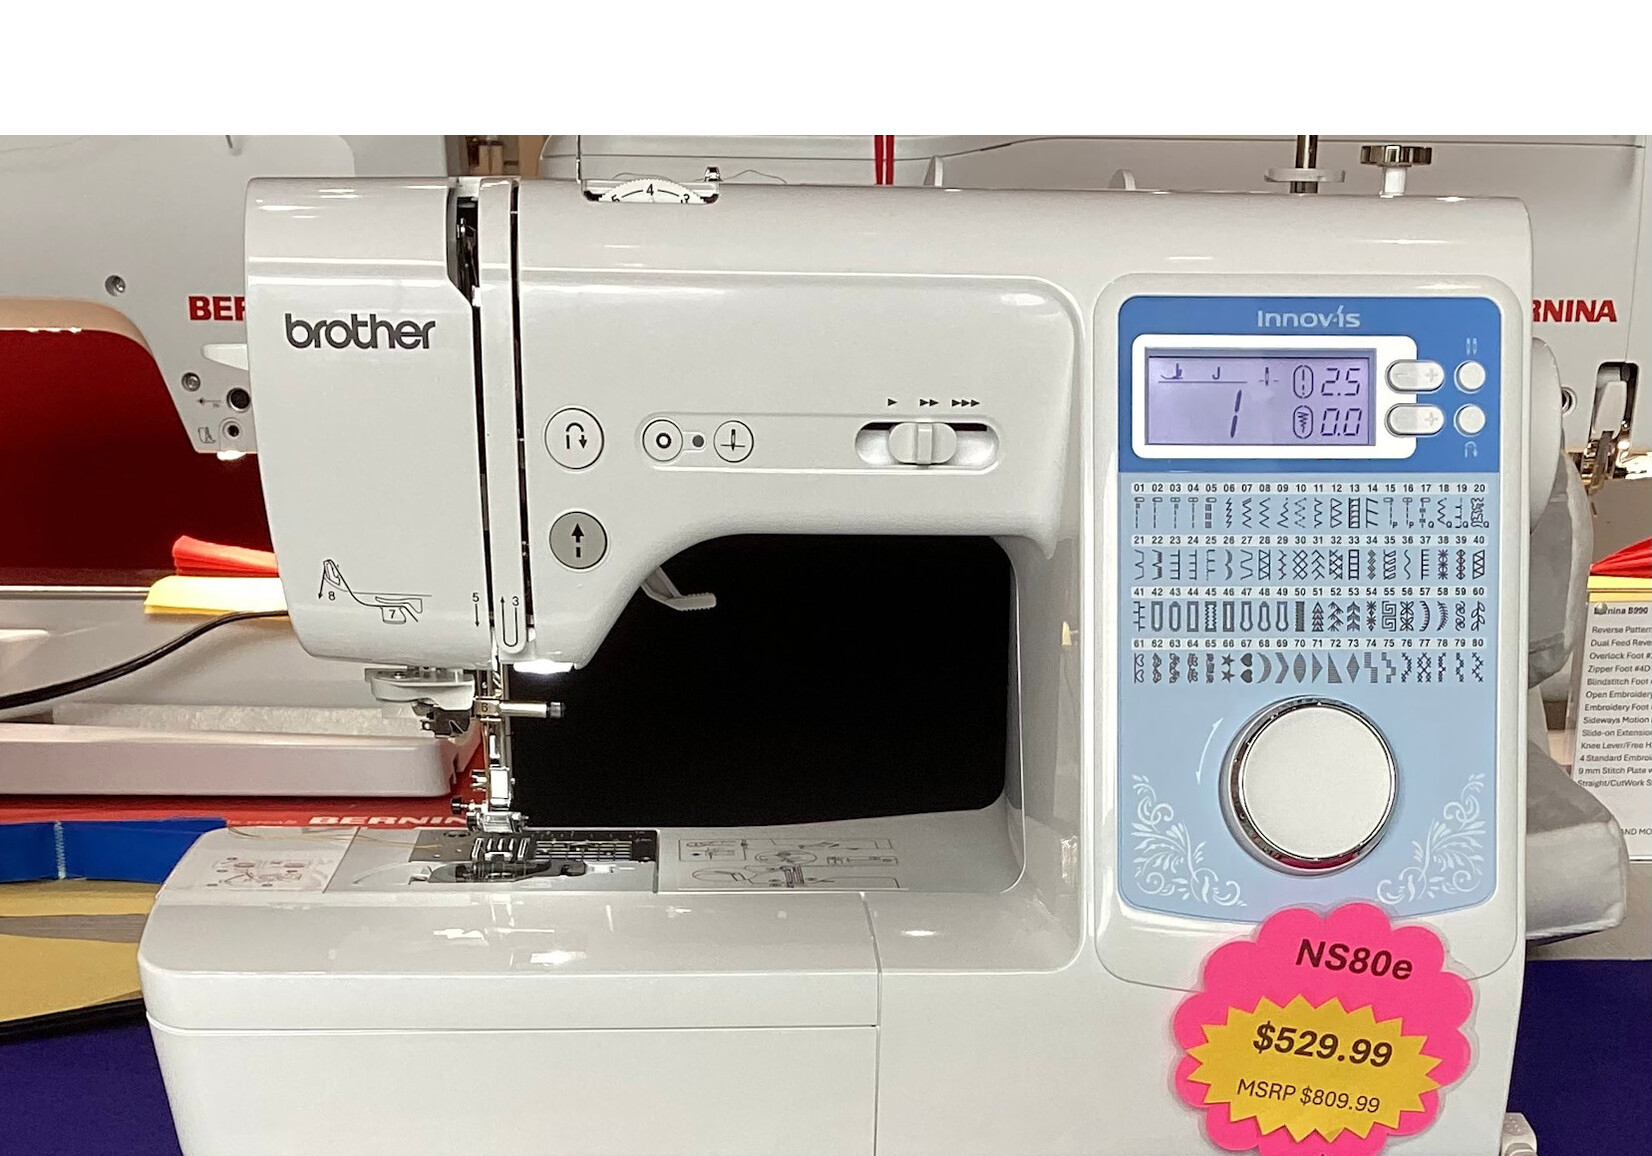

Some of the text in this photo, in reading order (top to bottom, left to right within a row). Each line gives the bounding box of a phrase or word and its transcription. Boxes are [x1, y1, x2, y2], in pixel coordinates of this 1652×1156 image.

[646, 183, 654, 196] 4
[285, 313, 436, 349] brother
[1321, 367, 1361, 396] 2.5
[1320, 407, 1363, 436] 0.0
[1133, 483, 1486, 493] 01 02 03 04 05 06 07 08 09 10 11 12 13 14 15 16 17 18 19 20
[1133, 535, 1485, 545] 21 22 23 24 25 26 27 28 29 30 31 32 33 34 35 36 37 38 39 40
[328, 591, 336, 601] 8
[1133, 586, 1485, 597] 41 42 43 44 45 46 47 48 49 50 51 52 53 54 55 56 57 58 59 60
[472, 592, 480, 603] 5
[512, 596, 520, 607] 3
[389, 609, 396, 619] 7
[1592, 626, 1624, 634] Reverse
[1133, 638, 1484, 648] 61 62 63 64 65 66 67 68 69 70 71 72 73 74 75 76 77 78 79 80
[1590, 639, 1631, 647] Dual Feed
[1589, 652, 1625, 660] Overlock
[1627, 652, 1644, 660] Foot
[1588, 665, 1613, 674] Zipper
[1615, 665, 1633, 673] Foot
[1587, 678, 1629, 686] Blindstitch
[1586, 691, 1607, 700] Open
[481, 703, 489, 713] 6
[1585, 703, 1649, 712] Embroidery Foot
[1583, 716, 1650, 725] Sideways Motion
[1582, 729, 1615, 737] Slide-on
[1580, 742, 1601, 750] Knee
[1602, 767, 1625, 775] Stitch
[1295, 938, 1413, 980] NS80e
[1253, 1020, 1393, 1067] $529.99
[1237, 1078, 1381, 1113] MSRP $809.99
